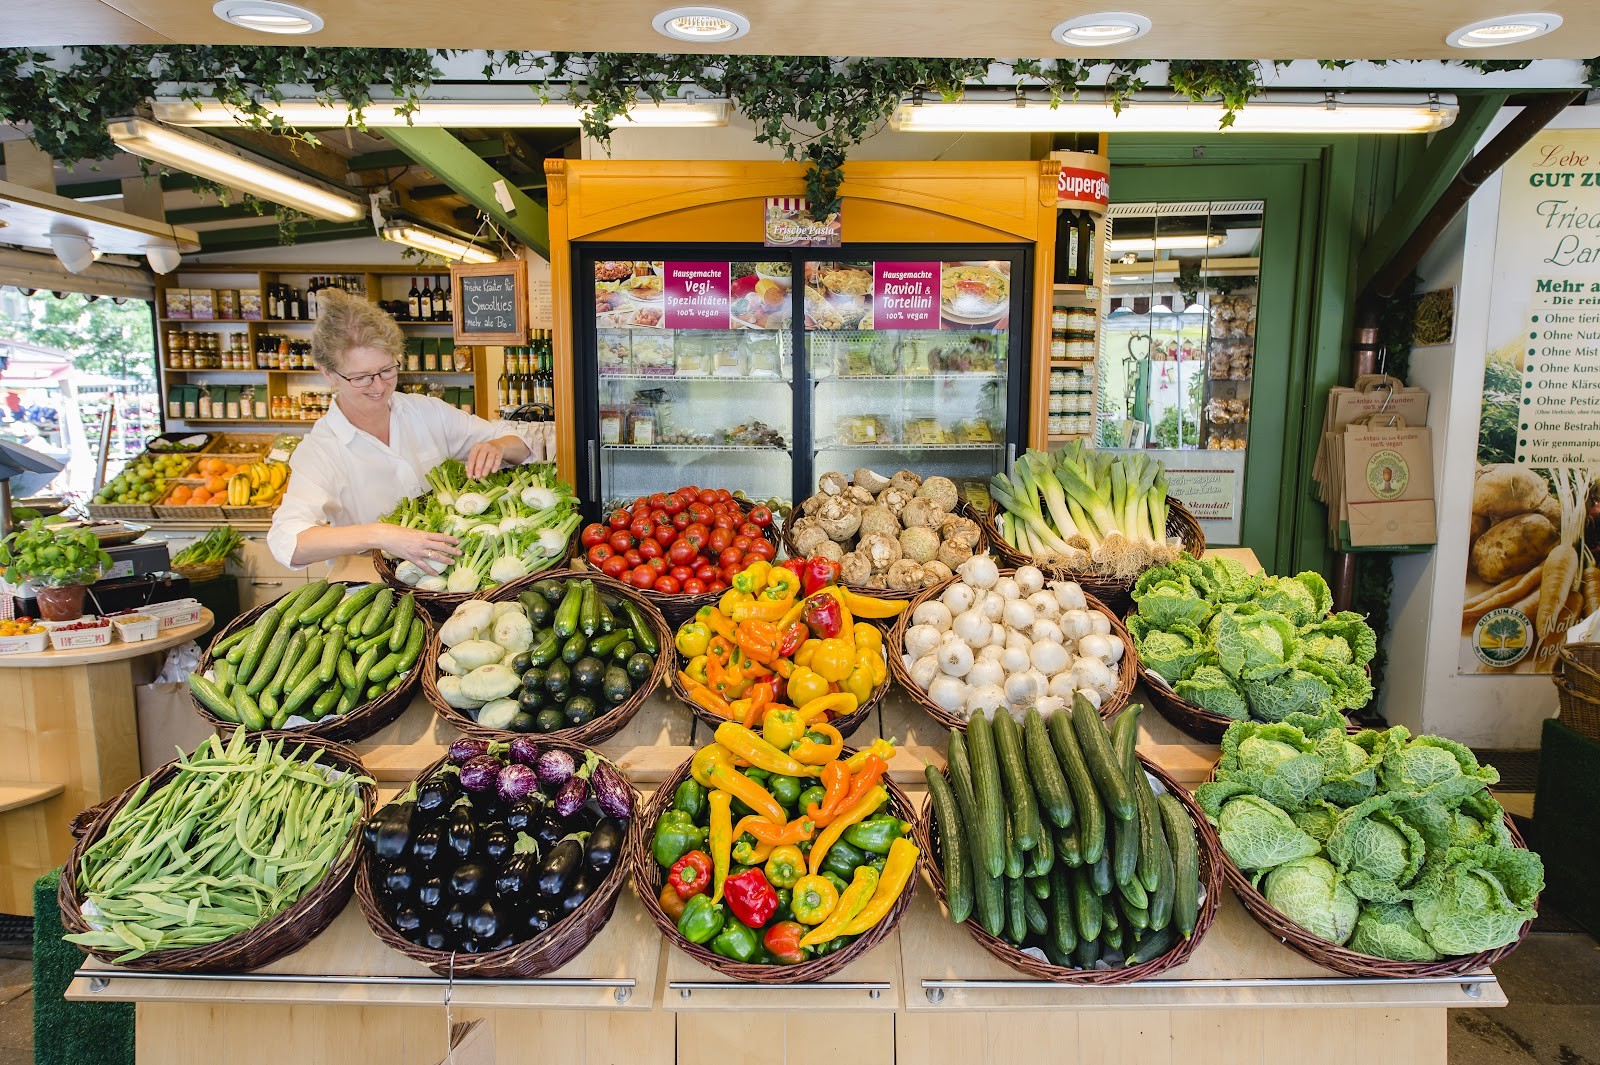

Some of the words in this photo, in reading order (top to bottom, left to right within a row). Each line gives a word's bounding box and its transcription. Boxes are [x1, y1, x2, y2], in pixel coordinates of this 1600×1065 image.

[1532, 144, 1589, 167] Lebe
[1529, 173, 1575, 187] GUT
[774, 225, 807, 236] Frische
[808, 225, 836, 236] Pasta
[673, 270, 722, 279] Hausgemachte
[883, 270, 933, 280] Hausgemachte
[504, 278, 514, 291] für
[685, 280, 715, 295] Vegi-
[884, 282, 922, 295] Ravioli
[924, 286, 931, 295] &
[1536, 279, 1585, 292] Mehr
[468, 295, 513, 315] Smoothies
[667, 296, 728, 306] Spezialitäten
[882, 296, 932, 309] Tortellini
[1552, 296, 1574, 305] Die
[677, 309, 695, 317] 100%
[697, 310, 719, 318] vegan
[886, 311, 904, 319] 100%
[906, 312, 929, 320] vegan
[1544, 314, 1575, 323] Ohne
[1578, 313, 1600, 323] tieri
[484, 316, 494, 328] als
[1543, 330, 1573, 340] Ohne
[1541, 347, 1571, 356] Ohne
[1575, 347, 1598, 356] Mist
[1540, 363, 1570, 373] Ohne
[1538, 380, 1568, 389] Ohne
[1536, 396, 1566, 406] Ohne
[1534, 421, 1561, 431] Ohne
[1532, 439, 1549, 447] Wir
[1531, 454, 1559, 463] Kontr.
[1562, 454, 1585, 463] ökol.
[1188, 501, 1230, 509] Skandal!
[1478, 613, 1491, 626] GUT
[1510, 610, 1530, 627] LEBEN
